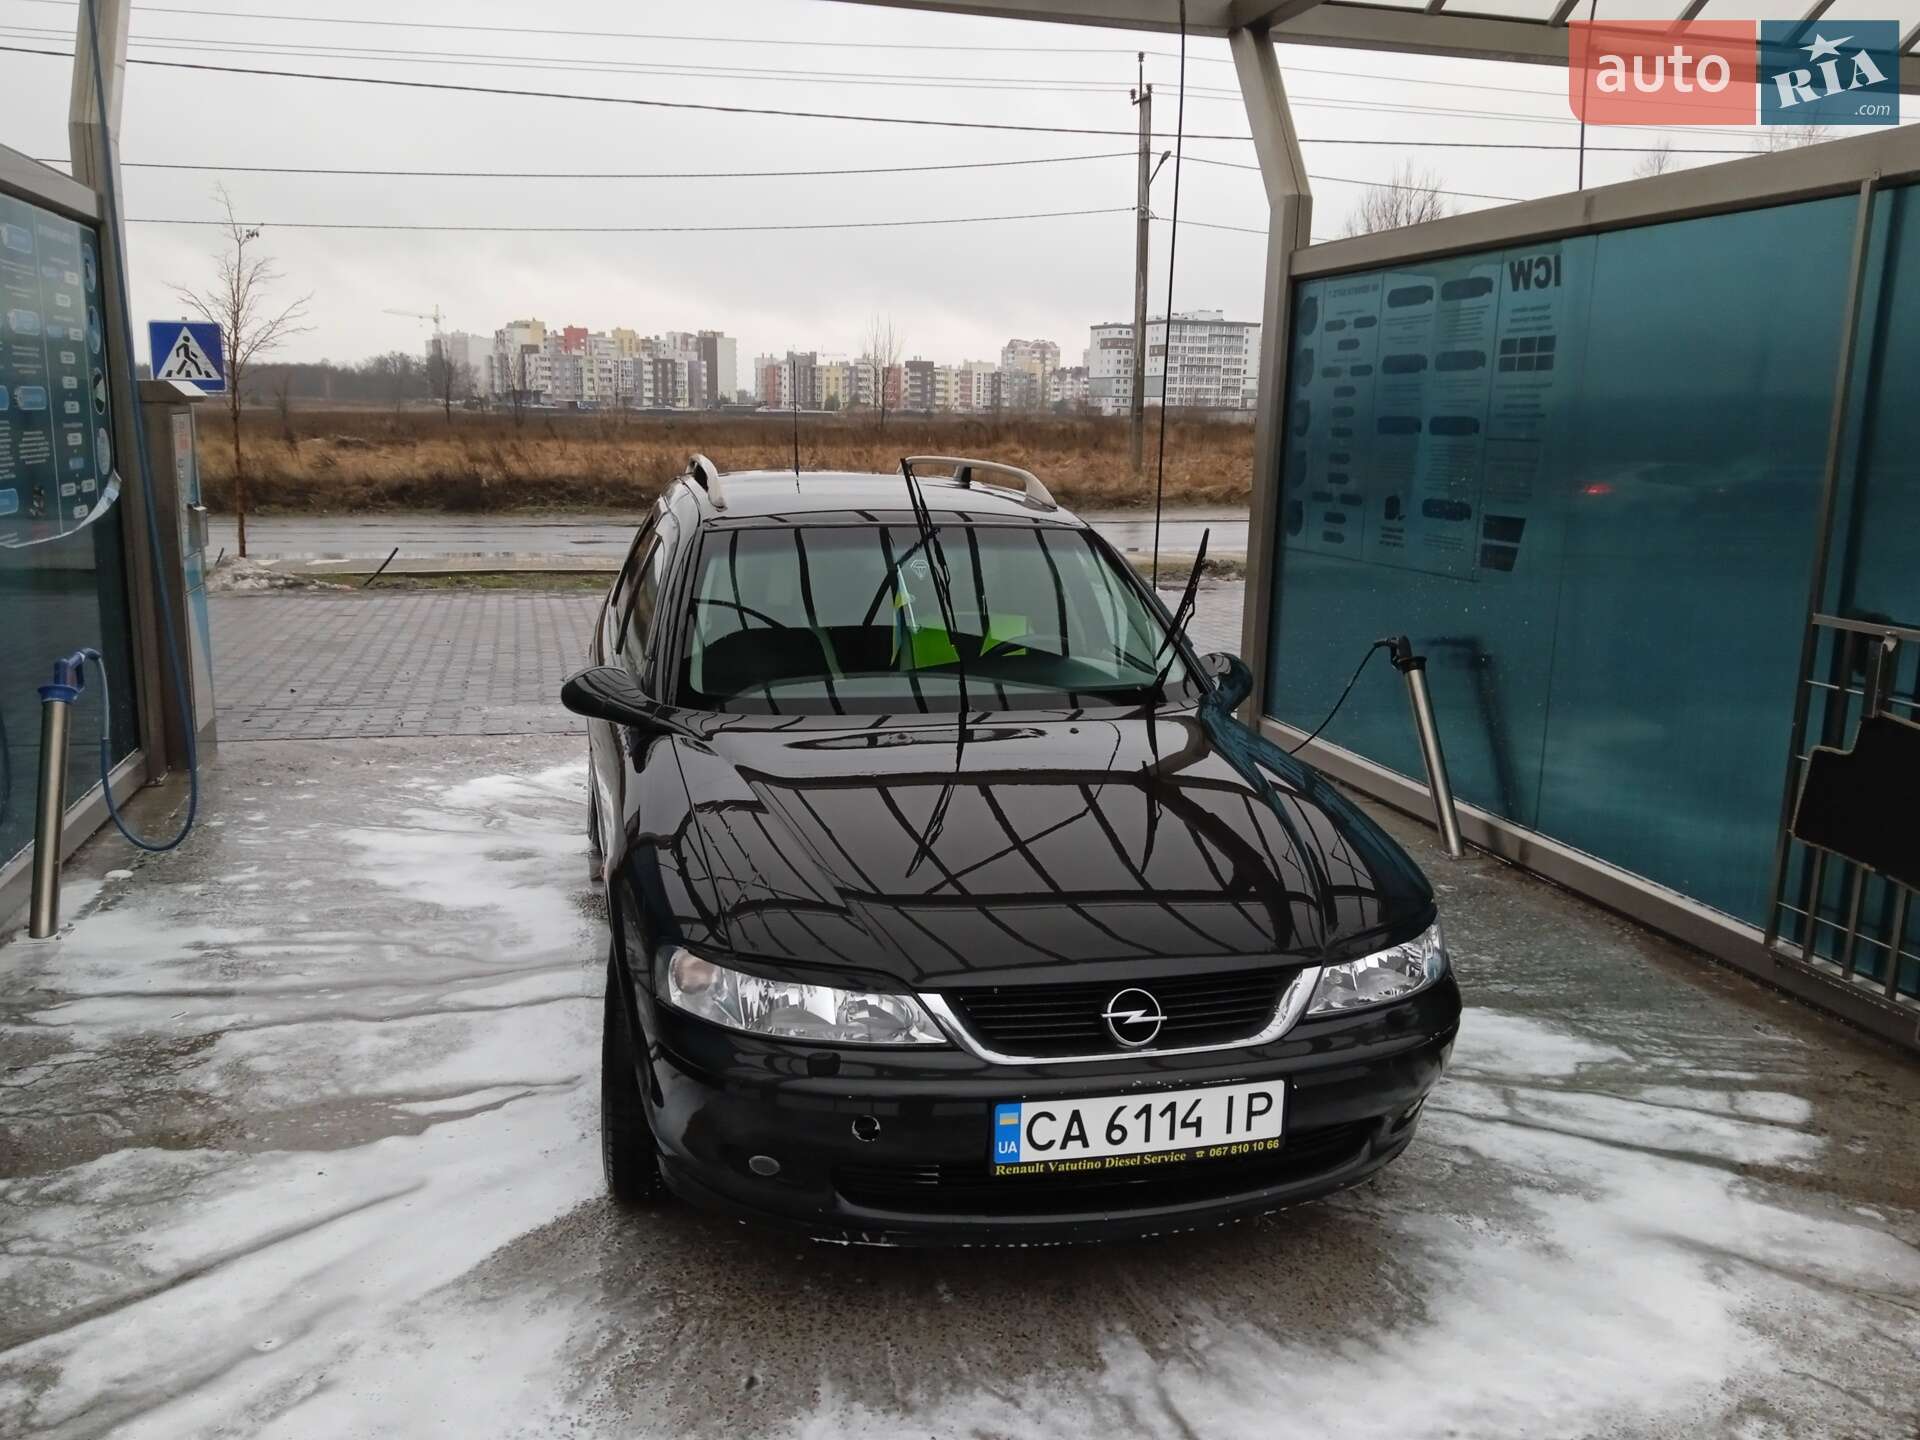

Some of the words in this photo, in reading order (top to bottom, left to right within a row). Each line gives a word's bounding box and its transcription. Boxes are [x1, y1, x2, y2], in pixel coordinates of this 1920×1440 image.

[1026, 1109, 1090, 1151] CA
[1105, 1098, 1203, 1146] 6114
[1225, 1091, 1274, 1135] IP
[995, 1162, 1045, 1176] Renault
[1049, 1159, 1102, 1172] Vatutino
[1104, 1155, 1141, 1168] Diesel
[1143, 1152, 1187, 1165] Service
[1209, 1147, 1228, 1157] 067
[1231, 1143, 1250, 1154] 810
[1253, 1141, 1265, 1151] 10
[998, 1141, 1018, 1154] UA
